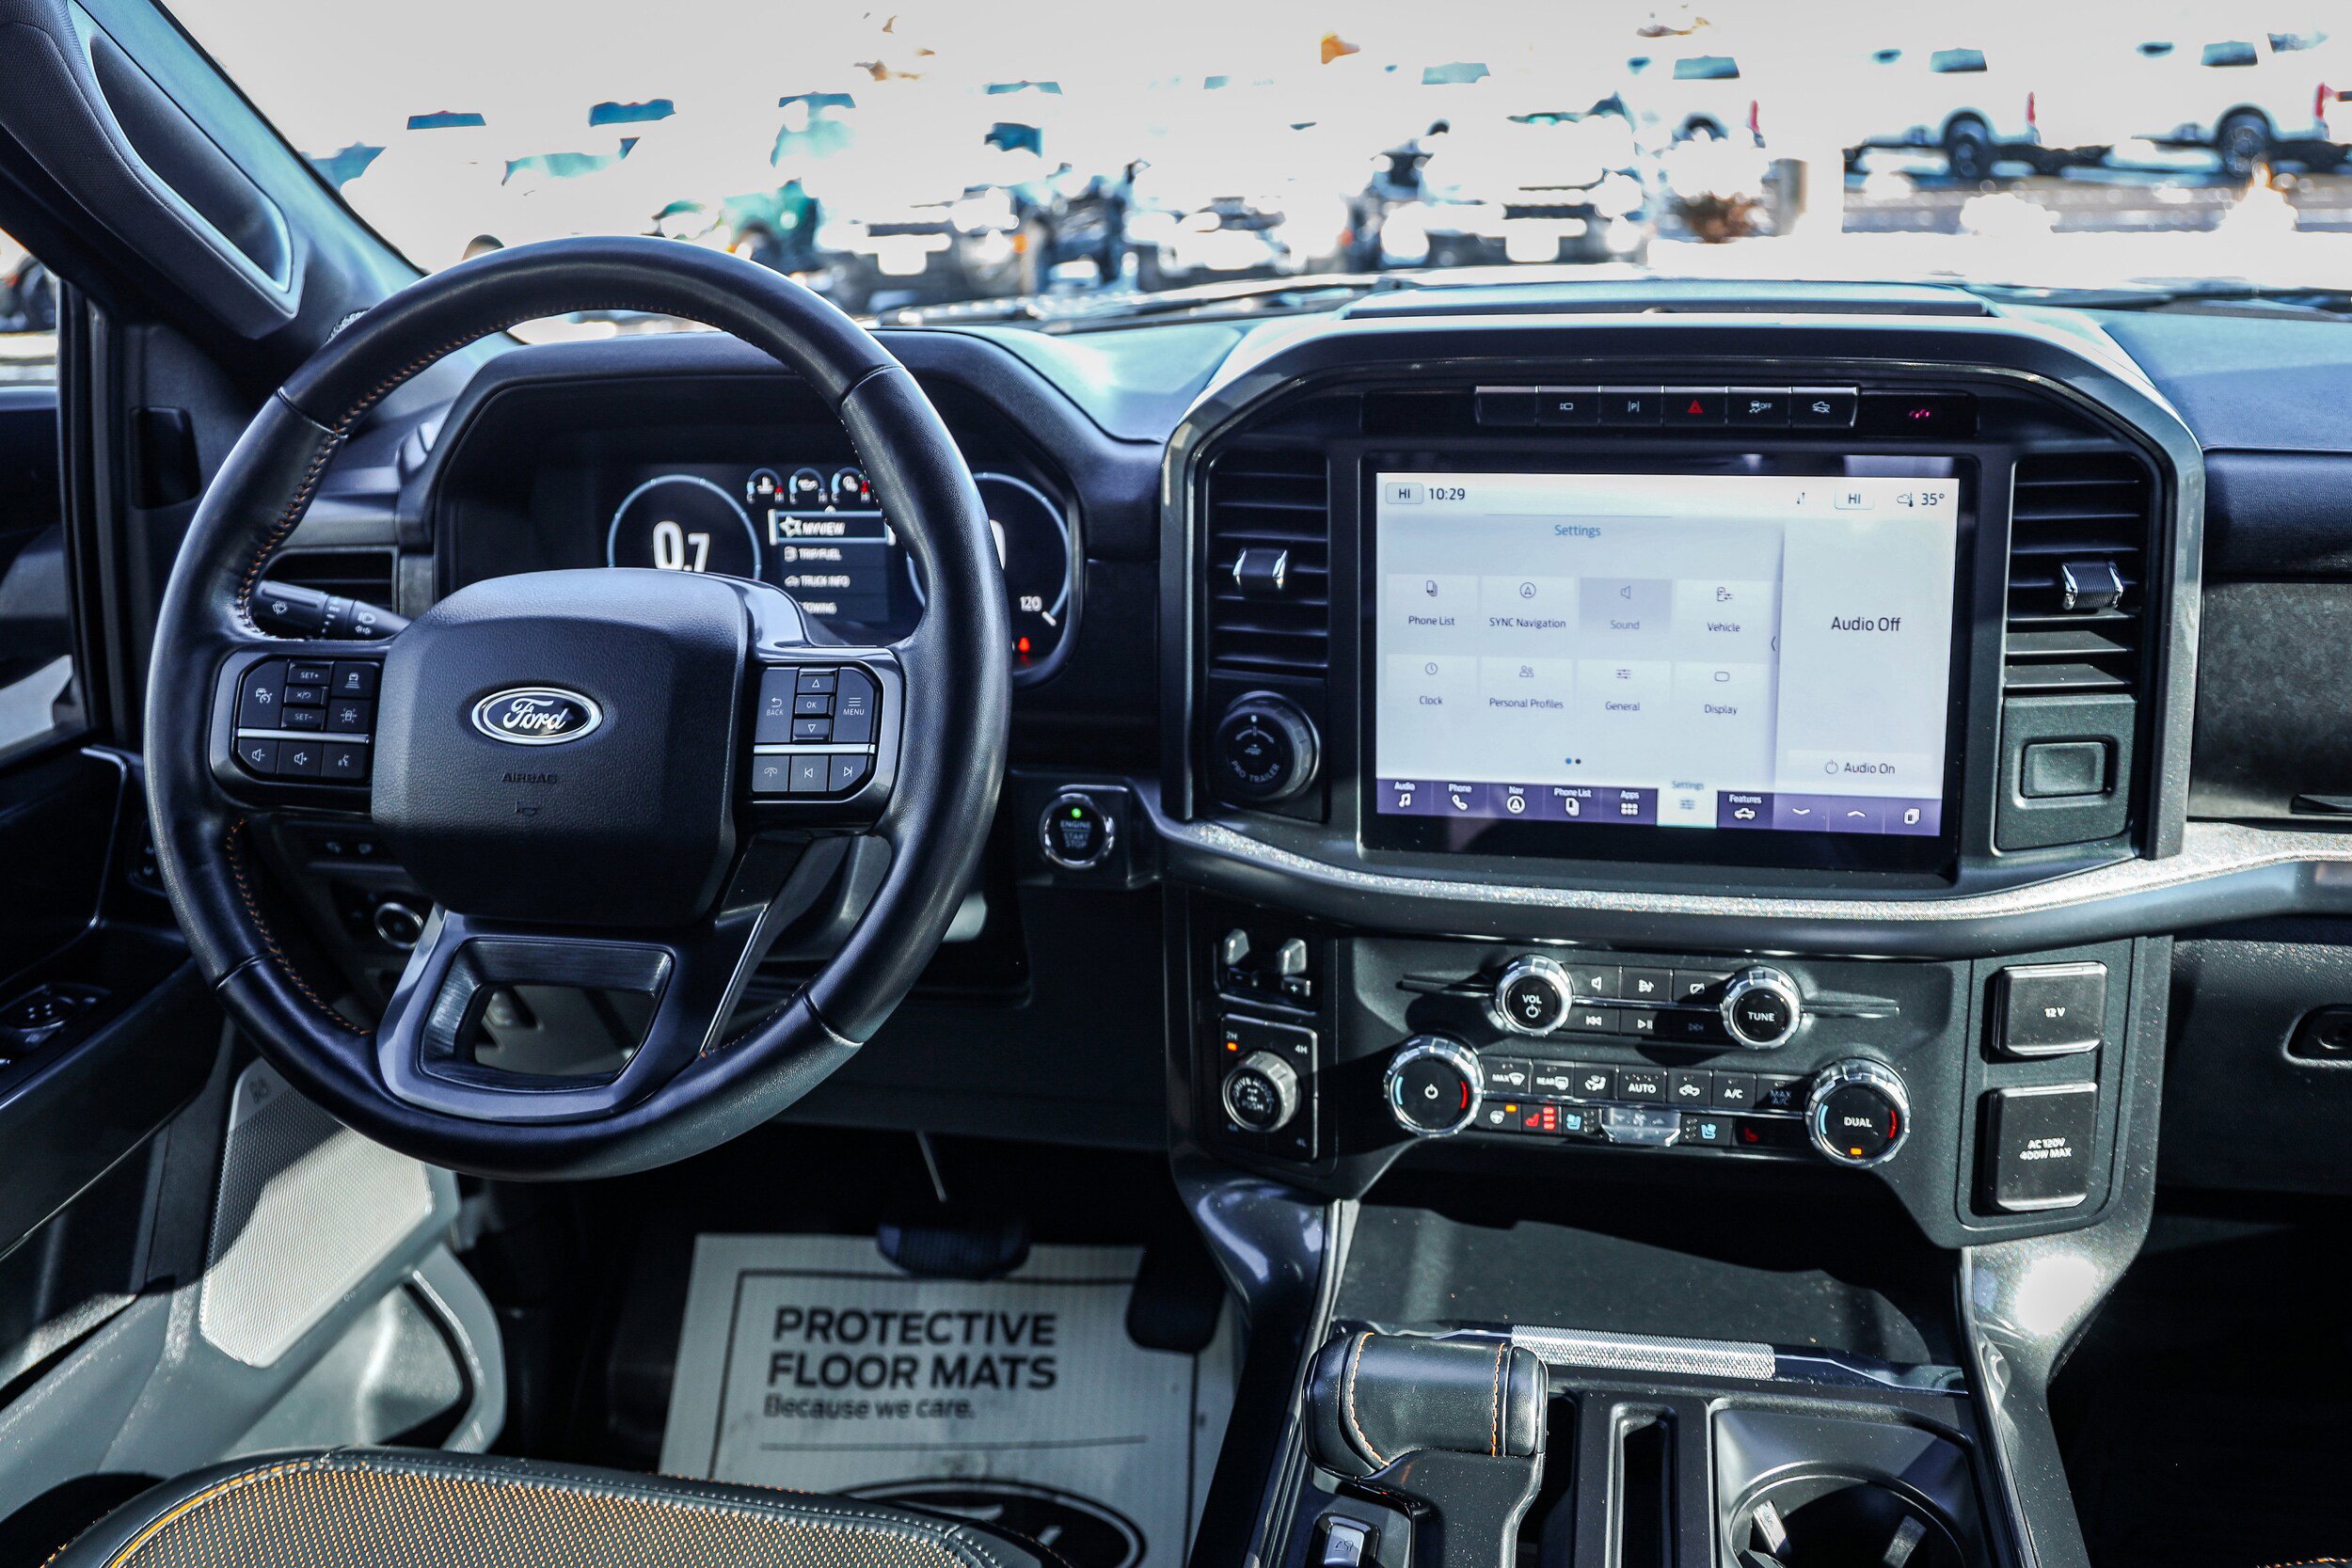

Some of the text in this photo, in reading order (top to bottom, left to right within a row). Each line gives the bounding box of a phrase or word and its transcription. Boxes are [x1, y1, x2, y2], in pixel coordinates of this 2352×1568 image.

[1398, 488, 1411, 499] HI
[1428, 487, 1466, 500] 10:29
[1847, 493, 1861, 504] HI
[1921, 492, 1946, 506] 35°
[802, 522, 846, 536] MYVIEW
[1554, 524, 1601, 538] Settings
[653, 520, 710, 573] 0.7
[799, 575, 850, 588] TRUCK INFO
[1020, 595, 1042, 611] 120
[1408, 615, 1455, 626] Phone List
[1489, 617, 1566, 630] SYNC Navigation
[1611, 619, 1640, 630] Sound
[1831, 616, 1901, 632] Audio Off
[1708, 622, 1740, 633] Vehicle
[1419, 695, 1443, 706] Clock
[1489, 698, 1564, 710] Personal Profiles
[1605, 701, 1641, 712] General
[1704, 704, 1738, 716] Display
[502, 697, 568, 730] Ford
[1232, 760, 1280, 783] PRO TRAILER
[1844, 763, 1896, 775] Audio On
[501, 771, 559, 784] AIRBAG
[1393, 781, 1416, 792] Audio
[1448, 783, 1472, 794] Phone
[1508, 785, 1524, 795] Nav
[1671, 780, 1705, 791] Settings
[1553, 786, 1592, 799] Phone List
[1620, 789, 1640, 800] Apps
[1728, 793, 1762, 804] Features
[1059, 819, 1091, 829] ENGINE
[1065, 840, 1088, 848] STOP
[1522, 994, 1542, 1005] VOL
[1747, 1011, 1775, 1022] TUNE
[1226, 1031, 1238, 1040] 2H
[1295, 1044, 1308, 1053] 4H
[1491, 1073, 1509, 1083] MAX
[1232, 1076, 1275, 1103] DRIVE MODE
[1628, 1083, 1657, 1094] AUTO
[1724, 1088, 1742, 1100] A/C
[1770, 1089, 1792, 1099] MAX
[1242, 1100, 1264, 1111] PUSH
[1843, 1117, 1872, 1128] DUAL
[2027, 1136, 2066, 1149] AC 120V
[2019, 1147, 2073, 1161] 400W MAX
[772, 1306, 1057, 1346] PROTECTIVE
[767, 1351, 1057, 1391] FLOOR MATS
[763, 1393, 976, 1420] Because we care.
